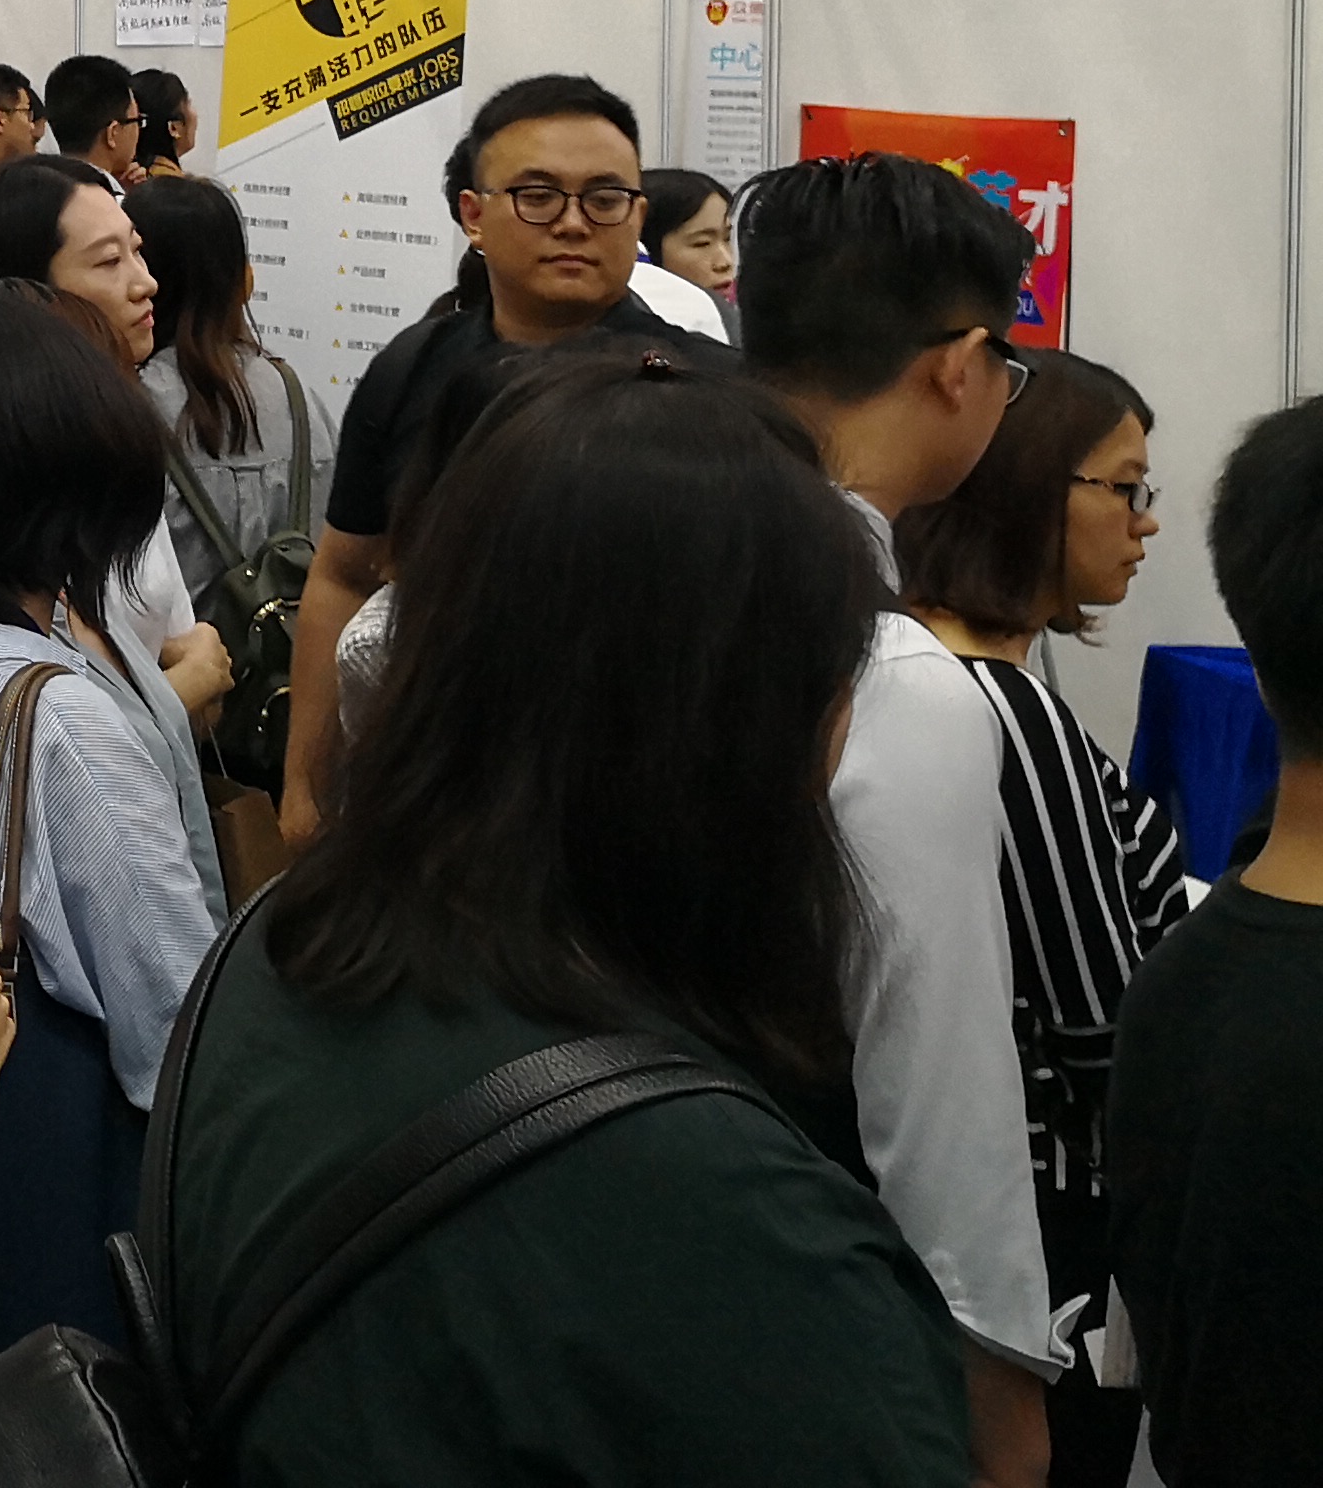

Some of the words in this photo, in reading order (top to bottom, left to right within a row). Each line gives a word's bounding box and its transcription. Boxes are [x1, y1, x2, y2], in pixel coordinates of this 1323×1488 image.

[239, 6, 447, 118] 一支充满活力的队伍
[418, 47, 460, 82] JOBS
[340, 68, 460, 132] REQUIREMENTS
